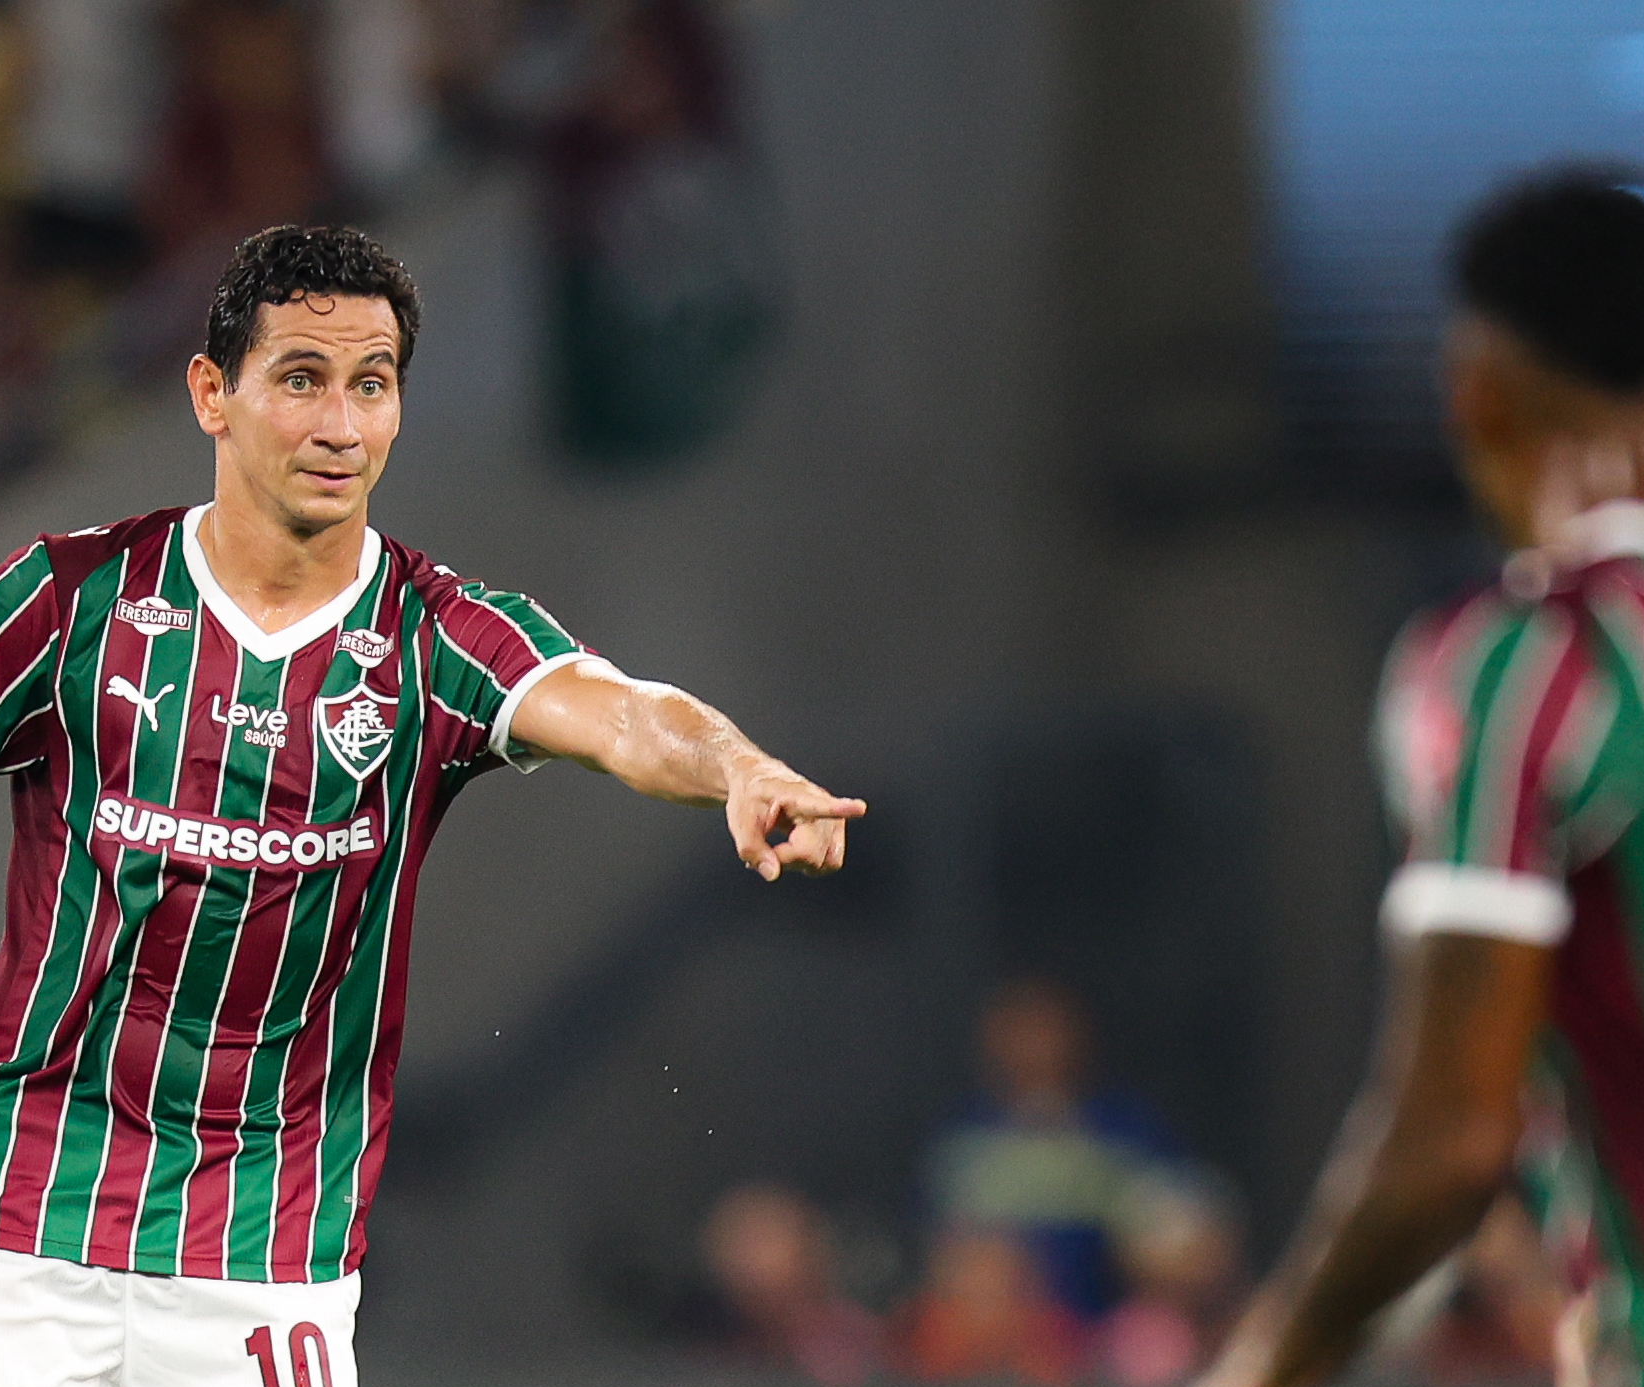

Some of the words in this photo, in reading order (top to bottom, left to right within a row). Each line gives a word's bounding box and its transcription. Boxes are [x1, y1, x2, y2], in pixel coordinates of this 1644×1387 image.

[119, 603, 188, 627] FRESCATTO
[337, 635, 392, 657] RESCATT
[211, 694, 289, 732] Leve
[244, 729, 287, 749] saúde
[95, 798, 375, 866] SUPERSCORE
